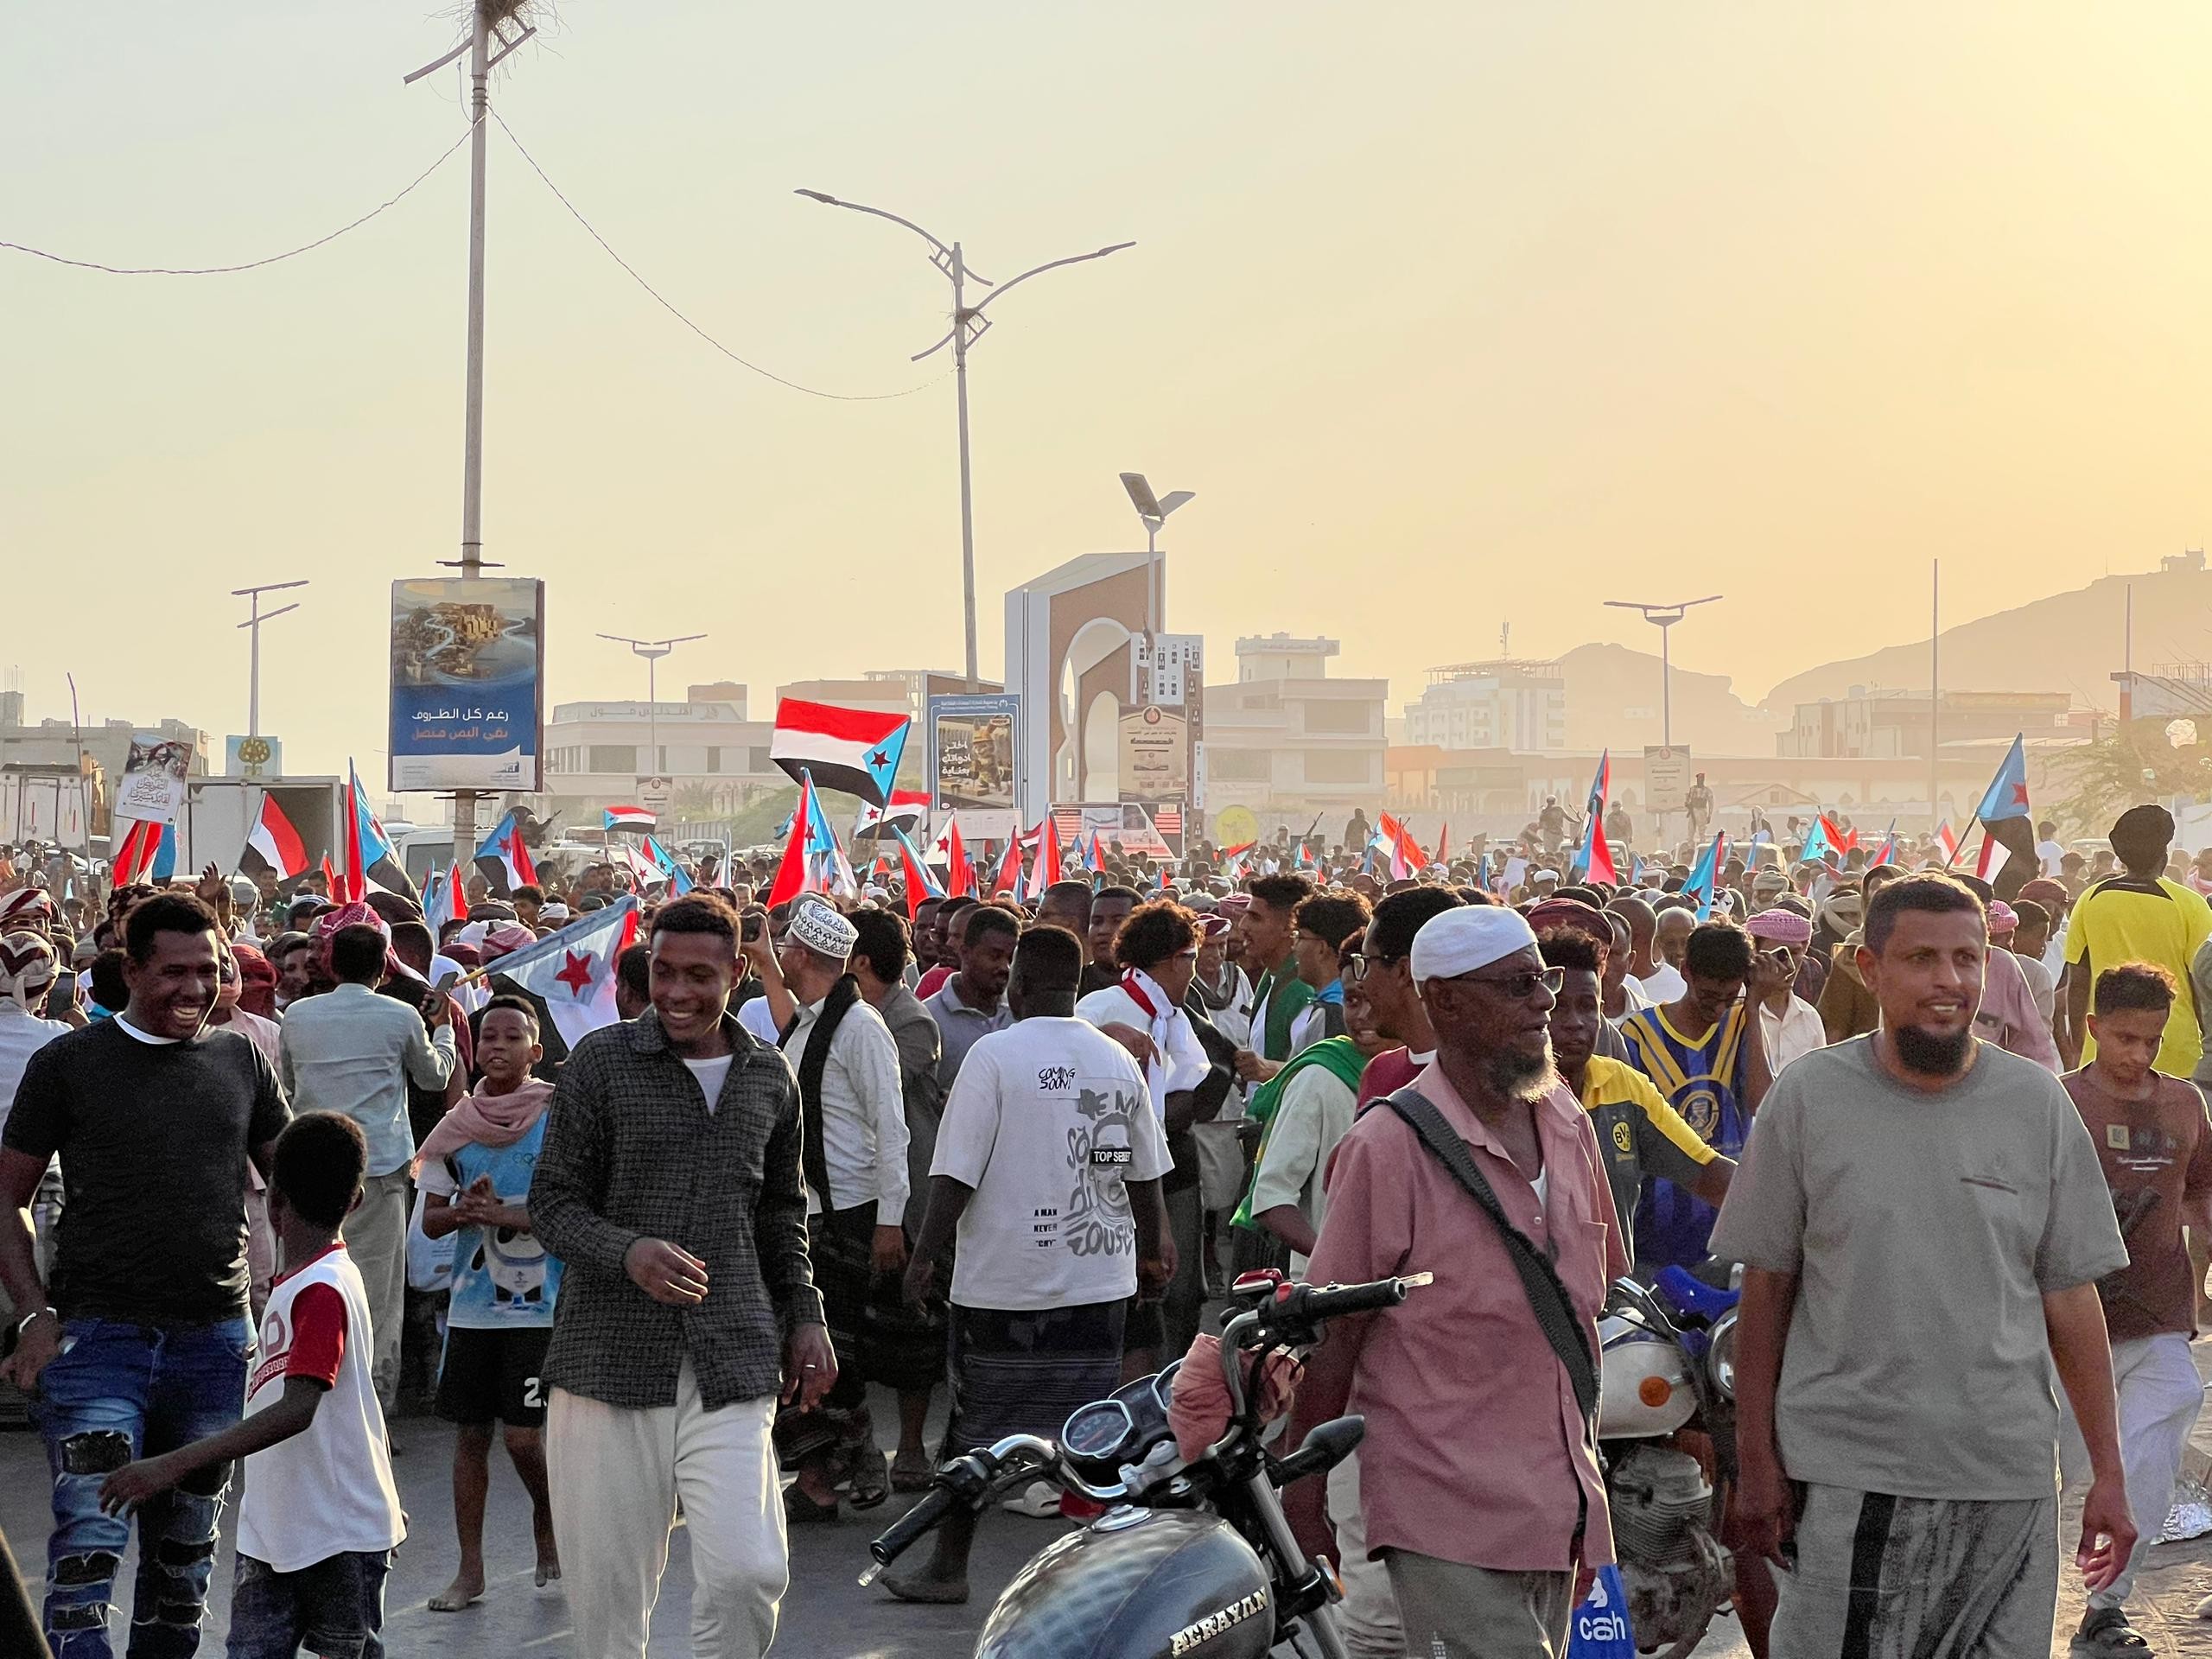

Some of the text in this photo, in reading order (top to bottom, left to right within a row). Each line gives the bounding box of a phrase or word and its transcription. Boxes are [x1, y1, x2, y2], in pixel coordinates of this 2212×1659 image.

[411, 708, 509, 722] رغم كل الظروف
[1039, 1066, 1076, 1079] COMING
[1094, 1151, 1113, 1162] TOP
[1033, 1224, 1058, 1233] NEVER
